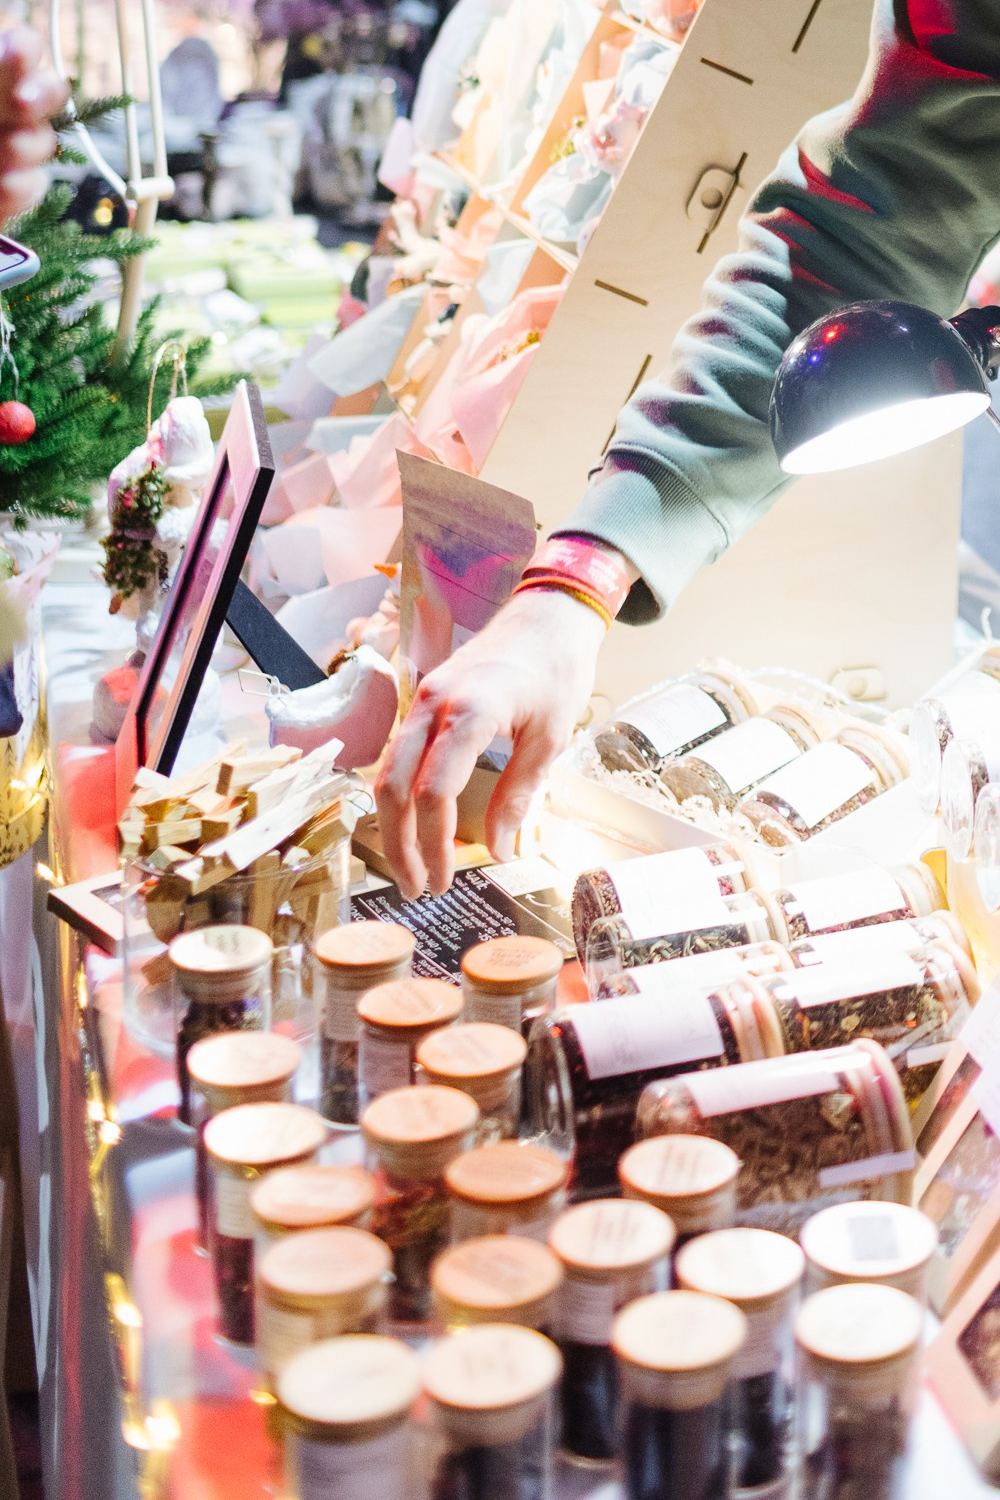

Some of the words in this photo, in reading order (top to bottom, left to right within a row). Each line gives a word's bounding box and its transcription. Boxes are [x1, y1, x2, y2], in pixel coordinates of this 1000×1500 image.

[465, 871, 491, 891] ЧАЙ:
[500, 916, 513, 925] 50
[438, 924, 459, 938] 55-70
